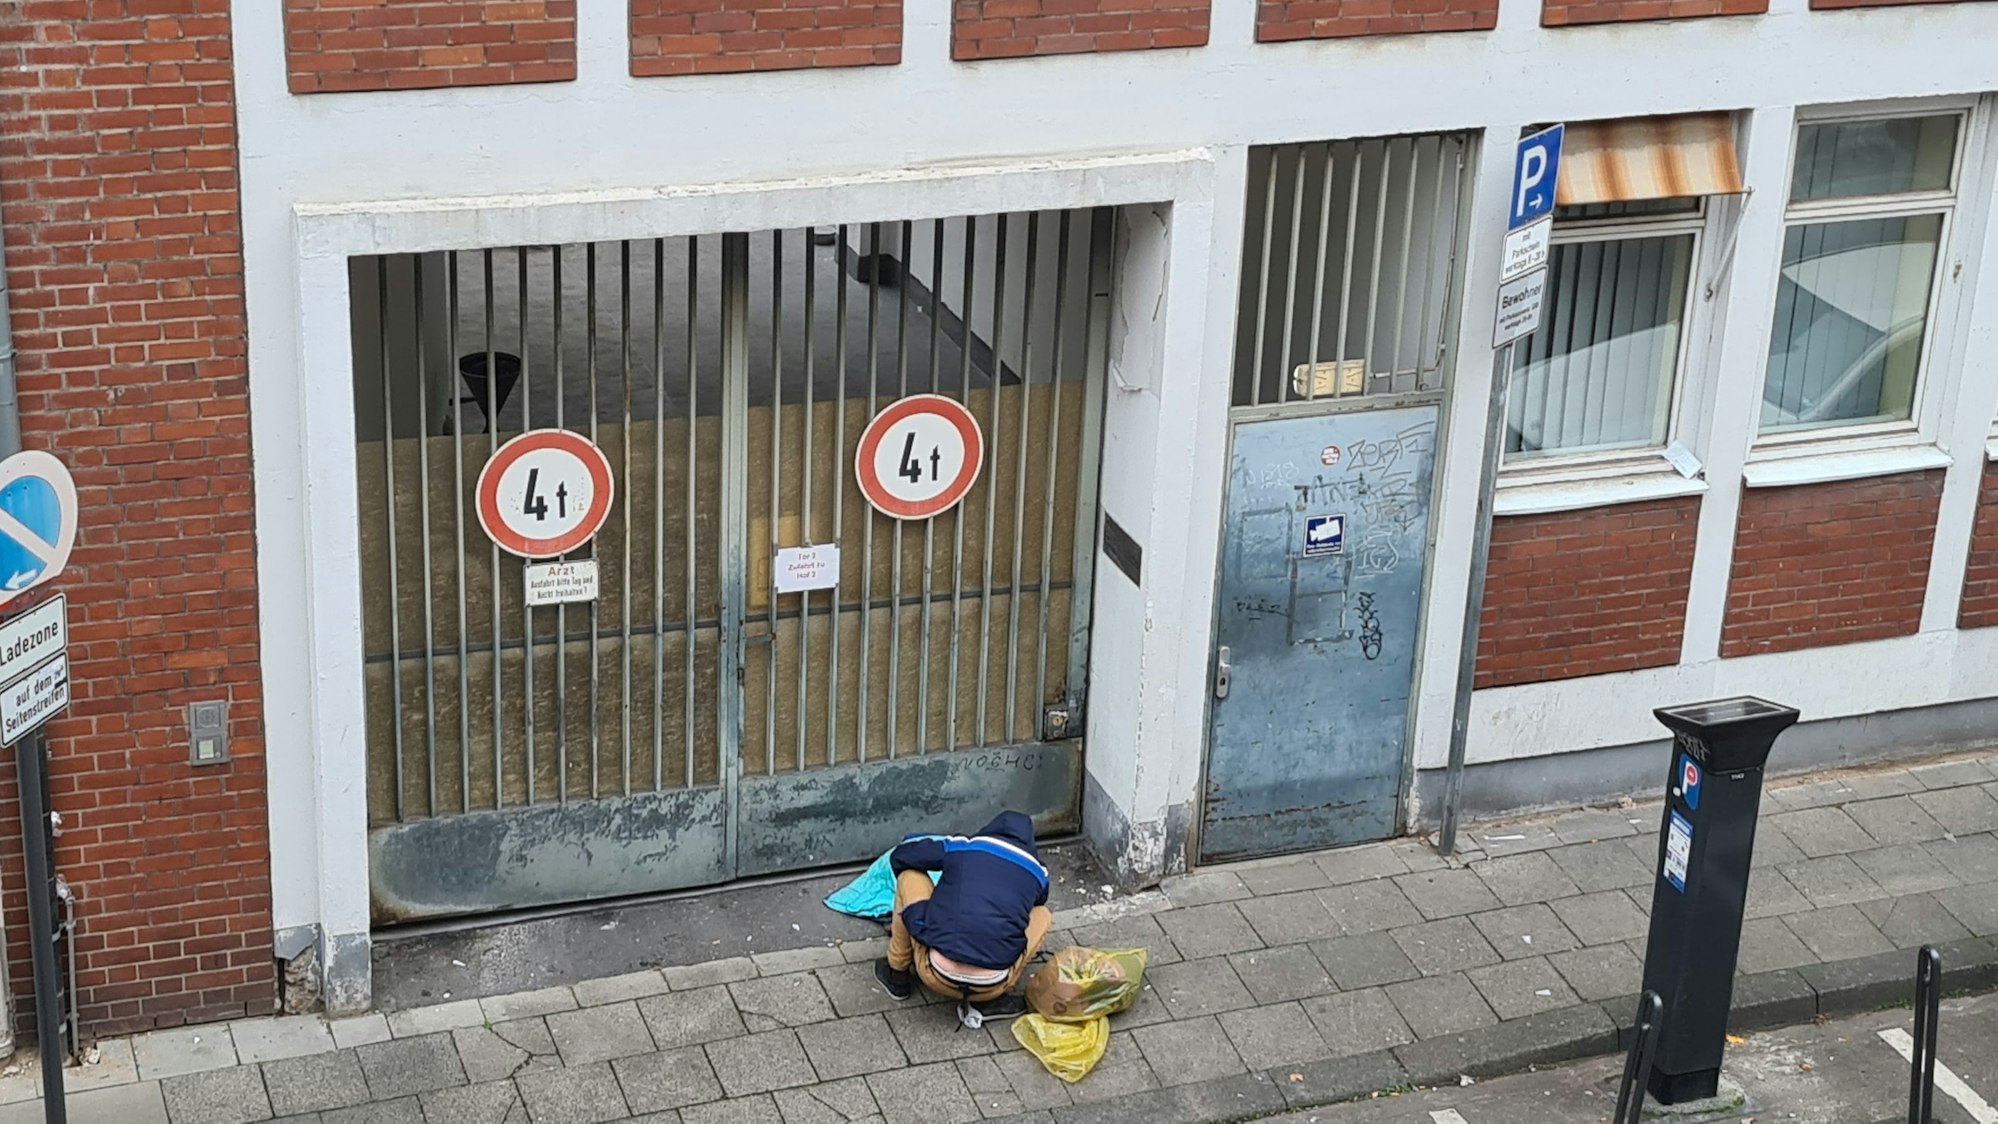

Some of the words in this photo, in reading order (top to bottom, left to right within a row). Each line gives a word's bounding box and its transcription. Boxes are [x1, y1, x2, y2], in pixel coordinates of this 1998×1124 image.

[1516, 145, 1548, 217] P
[1502, 284, 1542, 309] Bewohner
[899, 432, 922, 483] 4
[930, 444, 940, 481] t
[524, 468, 548, 521] 4
[556, 481, 567, 518] t
[548, 566, 575, 576] Arzt
[799, 553, 810, 561] Tor
[531, 579, 555, 588] Ausfahrt
[572, 576, 581, 585] Tag
[583, 575, 593, 584] und
[537, 590, 553, 599] Nacht
[0, 621, 59, 667] Ladezone
[16, 685, 30, 707] auf
[34, 675, 52, 696] dem
[6, 685, 65, 734] Seitenstreifen
